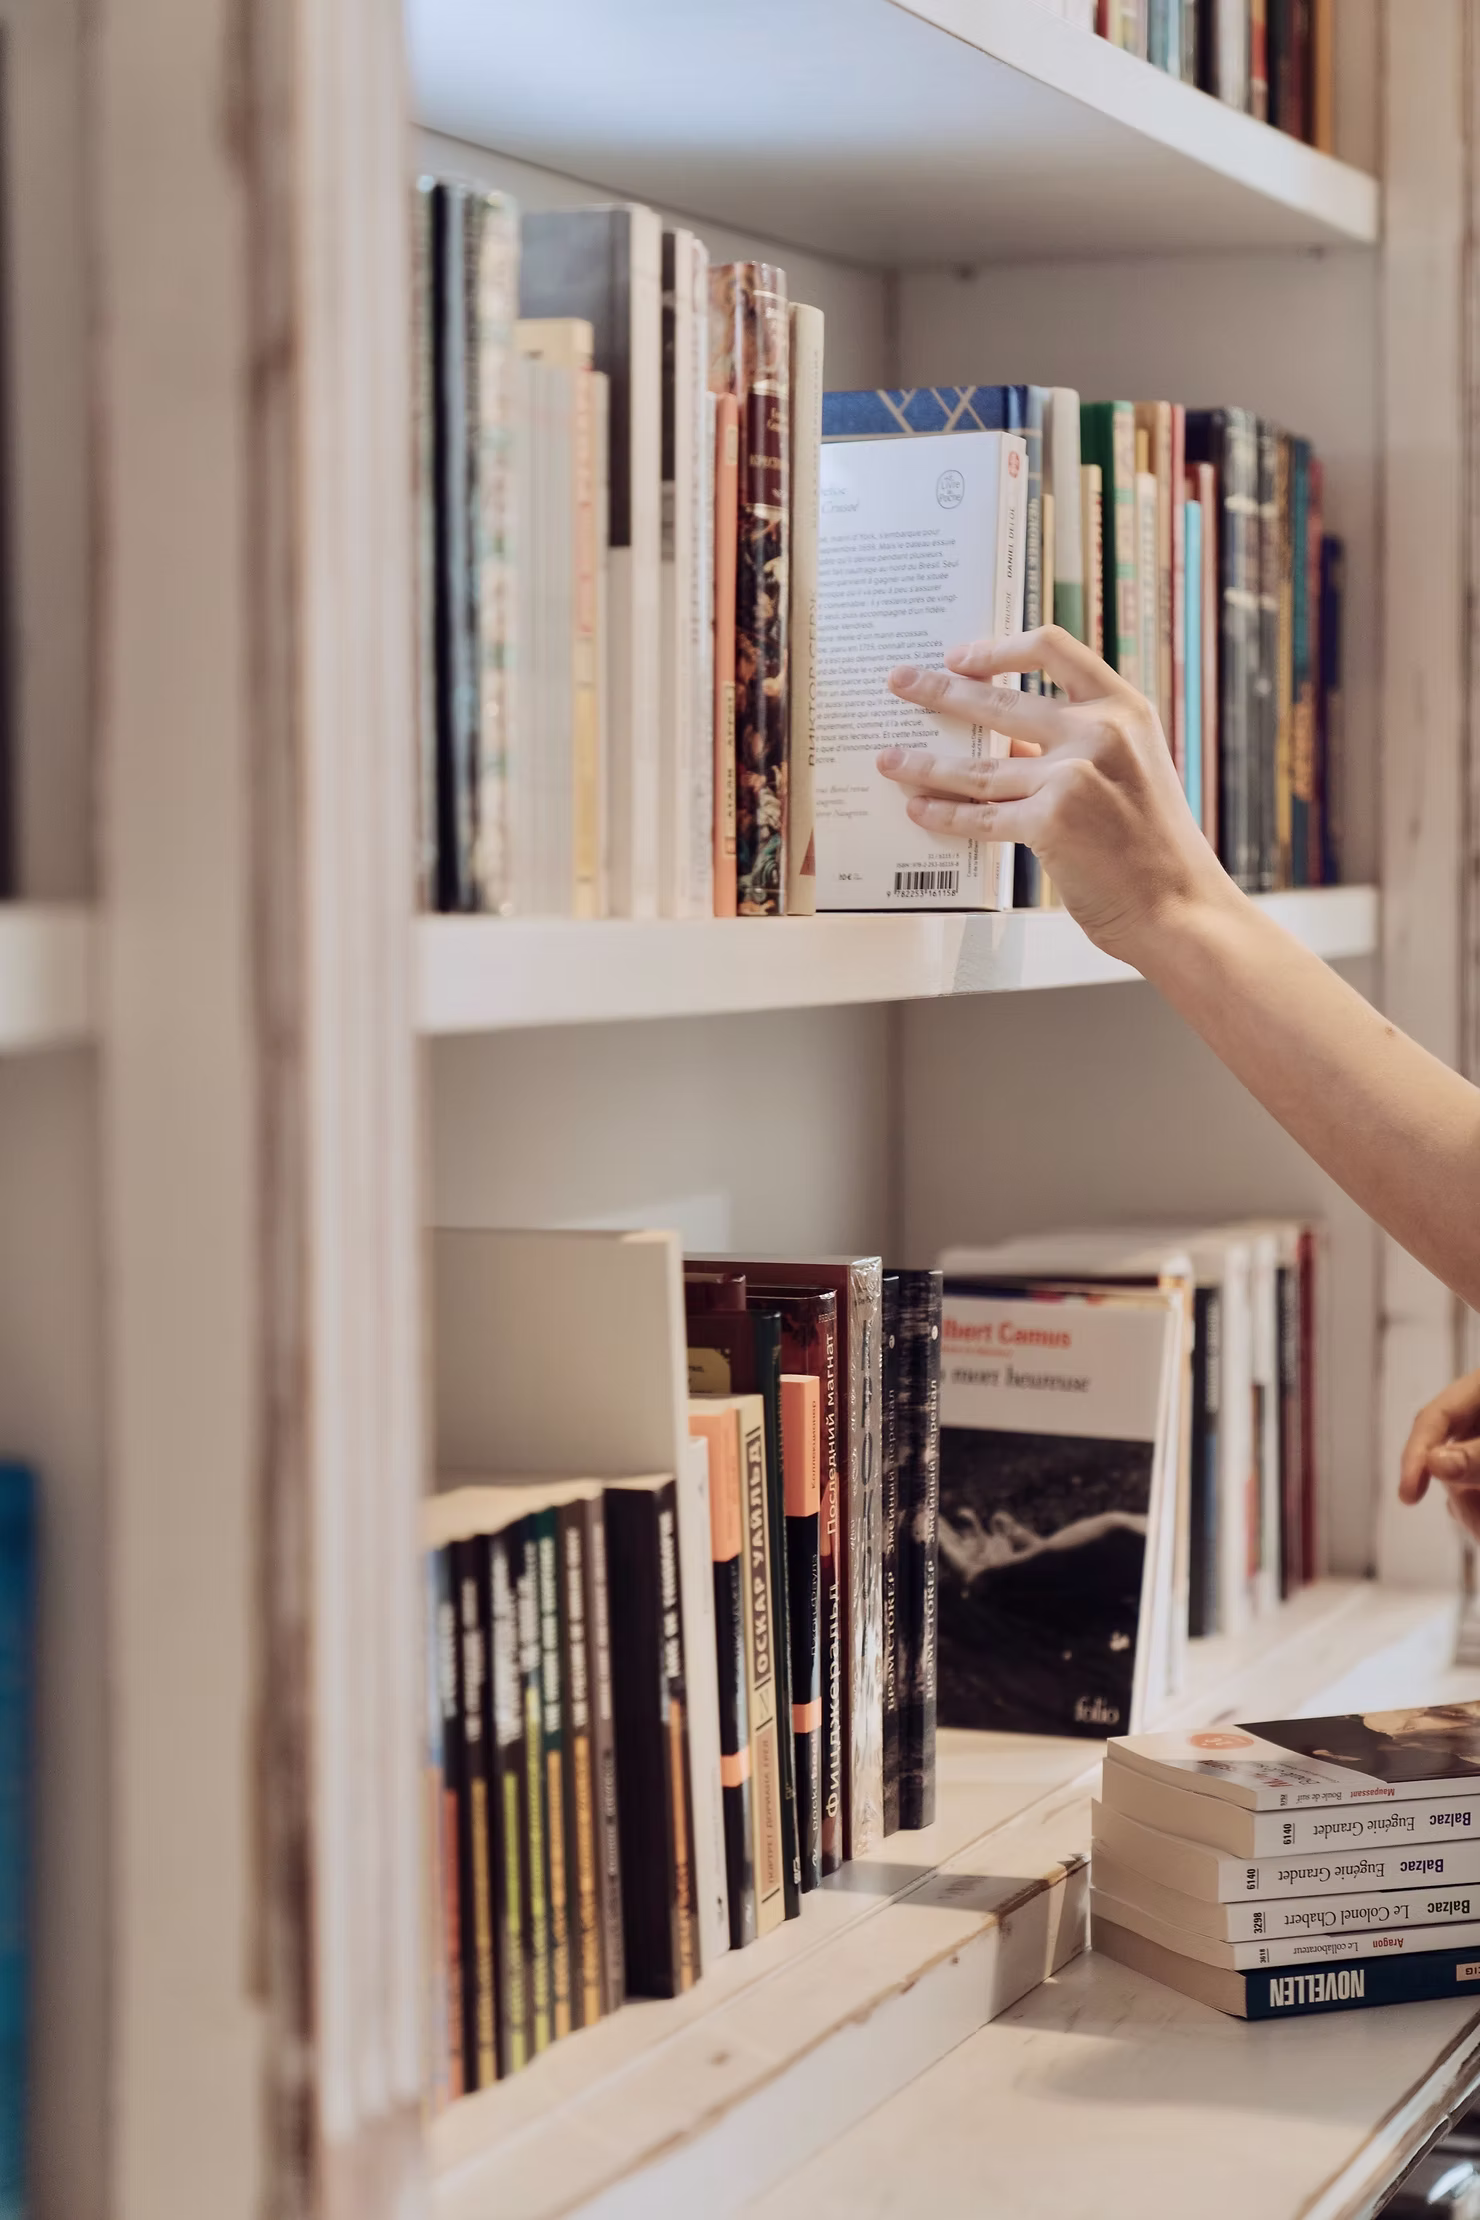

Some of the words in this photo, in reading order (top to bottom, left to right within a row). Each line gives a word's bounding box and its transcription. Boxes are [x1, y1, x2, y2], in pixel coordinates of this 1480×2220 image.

[896, 890, 925, 898] 782253
[928, 889, 957, 897] 161158
[944, 1319, 993, 1343] lbert
[998, 1320, 1073, 1349] Camus
[825, 1333, 836, 1406] магнат
[951, 1366, 1000, 1388] mort
[1005, 1364, 1091, 1394] heureuse
[886, 1389, 898, 1464] перевал
[927, 1379, 939, 1454] перевал
[824, 1413, 840, 1536] Последний
[746, 1439, 765, 1568] УАЙЛЬД
[886, 1472, 897, 1554] Змеиный
[926, 1461, 938, 1543] Змеиный
[886, 1571, 896, 1651] СТОКЕР
[926, 1560, 937, 1643] СТОКЕР
[752, 1574, 769, 1673] ОСКАР
[825, 1582, 842, 1819] Фицджеральд
[1073, 1696, 1120, 1725] folio
[810, 1732, 819, 1831] pocketbook
[1350, 1787, 1396, 1798] Maupassant
[1312, 1792, 1321, 1801] de
[1322, 1791, 1343, 1800] Boule
[1312, 1820, 1363, 1839] Grandet
[1367, 1814, 1415, 1834] Eugénie
[1429, 1812, 1472, 1827] Balzac
[1282, 1823, 1293, 1845] 6140
[764, 1834, 775, 1884] ПОРТРЕТ
[1334, 1860, 1385, 1880] Eugénie
[1399, 1858, 1444, 1873] Balzac
[1246, 1868, 1256, 1890] 6140
[1277, 1866, 1331, 1884] Grandet
[1284, 1908, 1337, 1927] Chabert
[1340, 1905, 1390, 1925] Colonel
[1393, 1904, 1410, 1920] Le
[1426, 1899, 1471, 1914] Balzac
[1253, 1912, 1263, 1934] 3298
[1292, 1942, 1349, 1955] collaborateur
[1349, 1941, 1359, 1952] Le
[1372, 1937, 1404, 1949] Aragon
[1269, 1968, 1366, 2008] NOVELLEN
